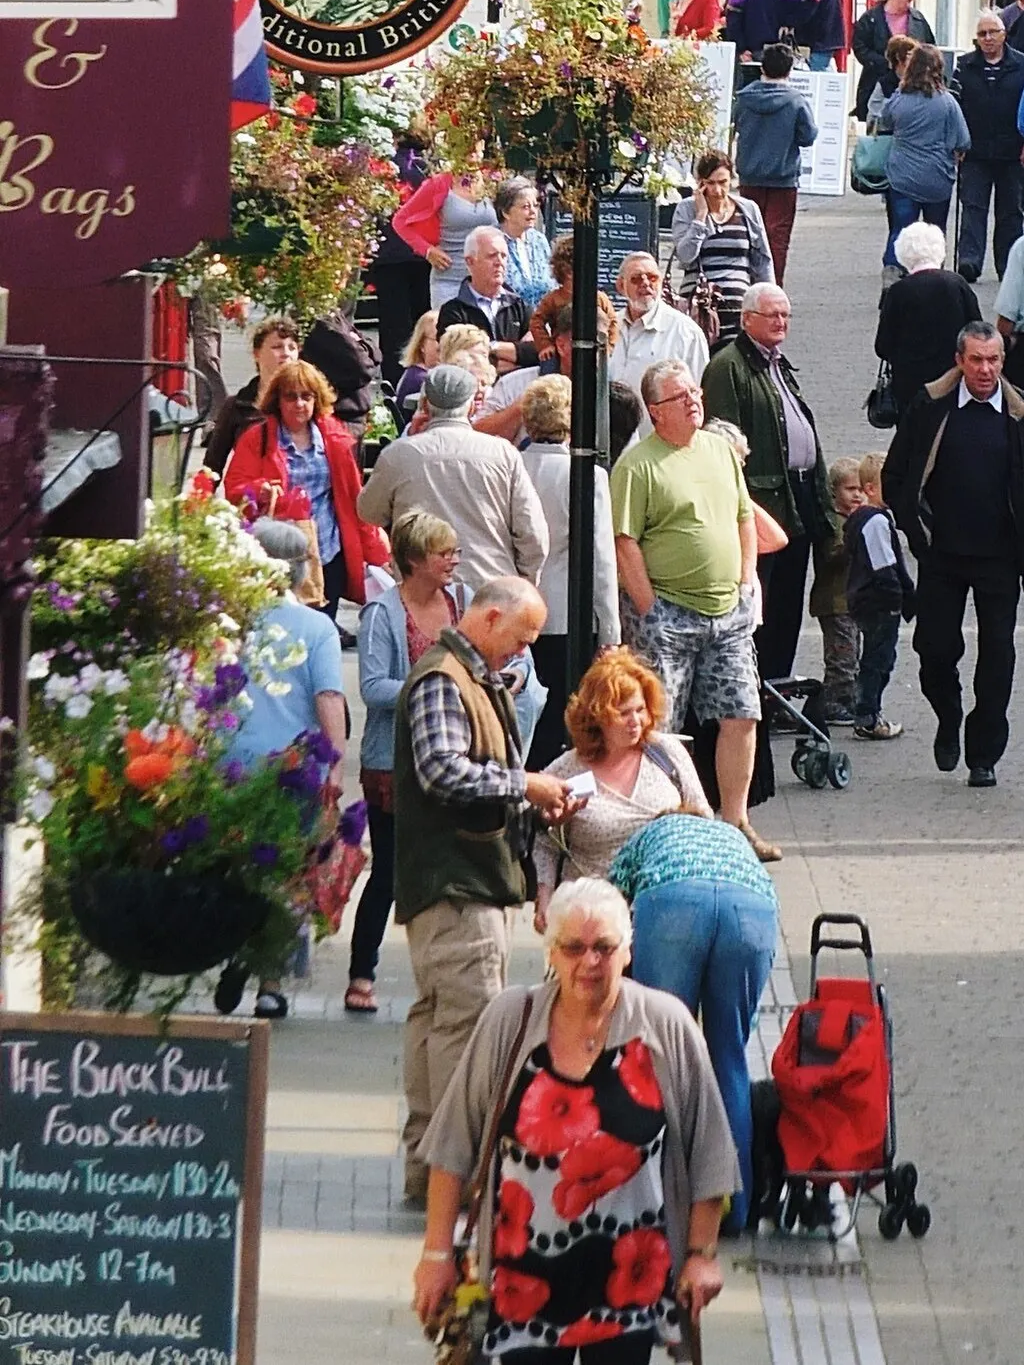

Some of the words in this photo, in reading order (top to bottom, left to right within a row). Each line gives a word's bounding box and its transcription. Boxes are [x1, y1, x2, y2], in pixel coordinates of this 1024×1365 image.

[0, 121, 136, 240] Bags
[1, 1041, 62, 1099] THE
[43, 1104, 110, 1147] FOOD
[109, 1104, 205, 1148] SERVED
